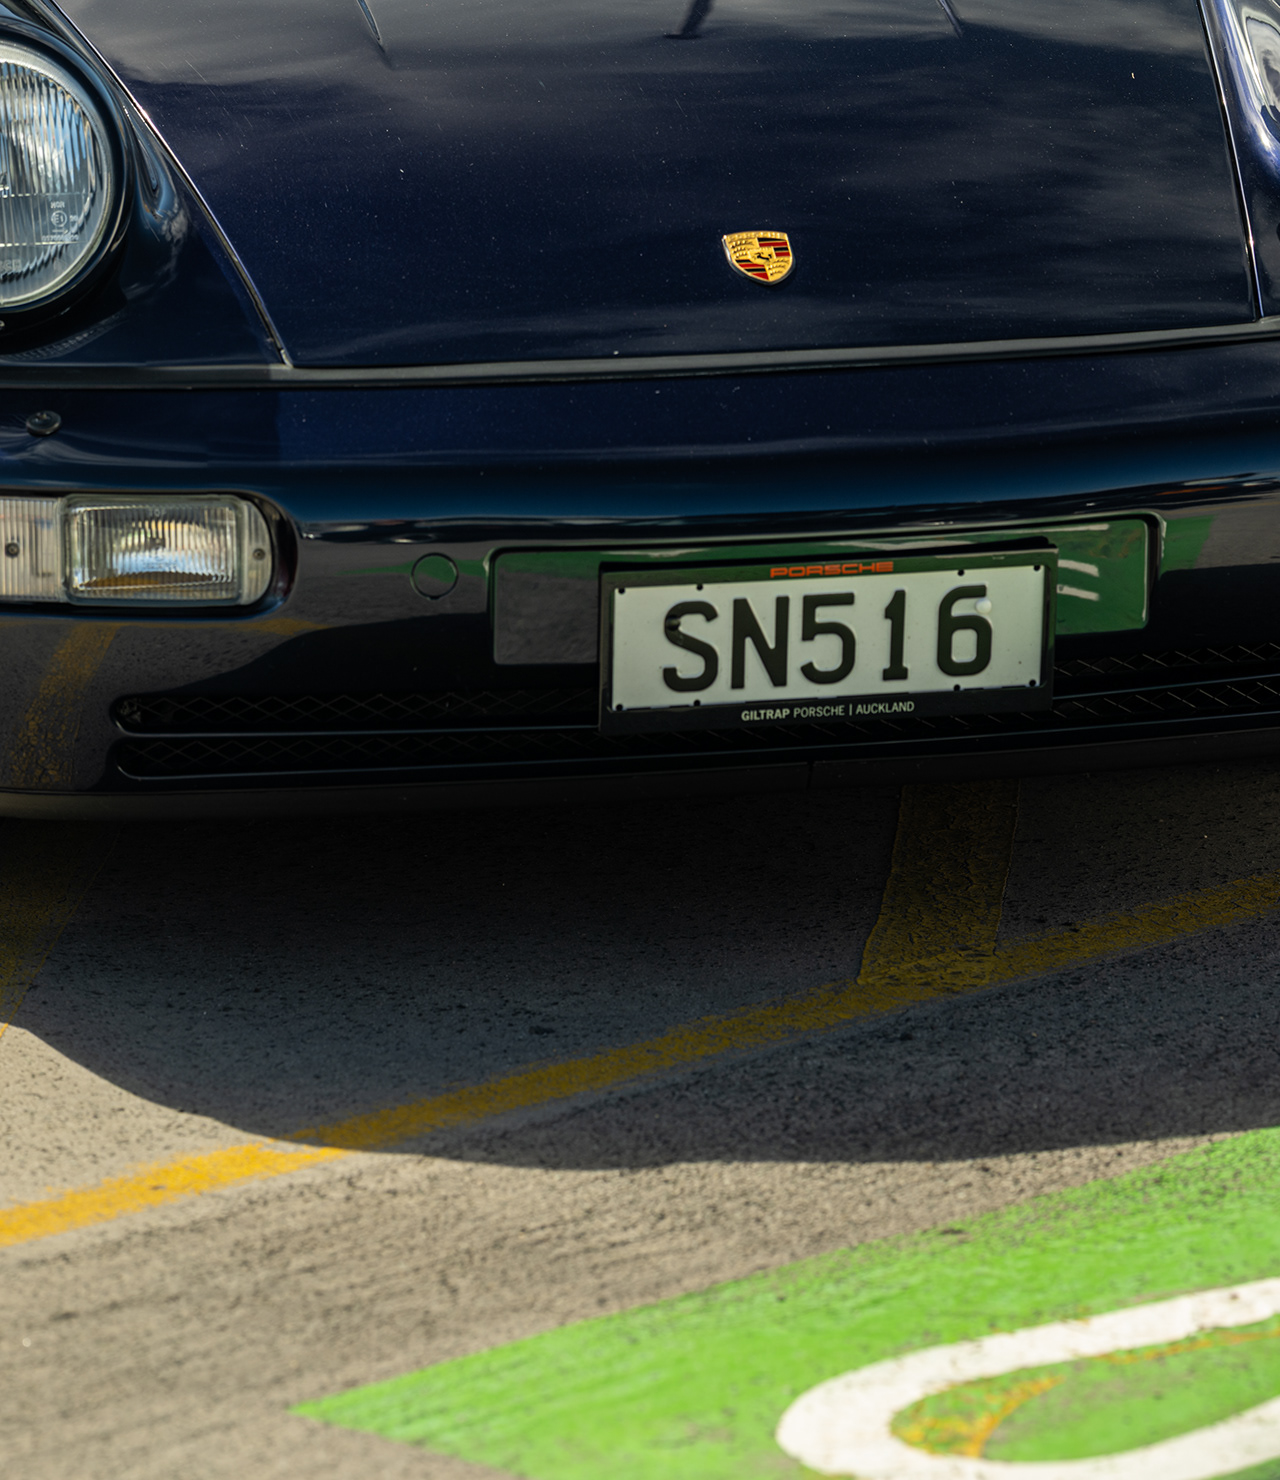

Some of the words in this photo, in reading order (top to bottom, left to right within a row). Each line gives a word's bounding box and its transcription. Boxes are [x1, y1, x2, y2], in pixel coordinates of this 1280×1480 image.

[769, 561, 894, 579] PORSCHE
[662, 583, 993, 692] SN516
[740, 708, 791, 722] GILTRAP
[793, 704, 846, 719] PORSCHE
[855, 700, 916, 715] AUCKLAND
